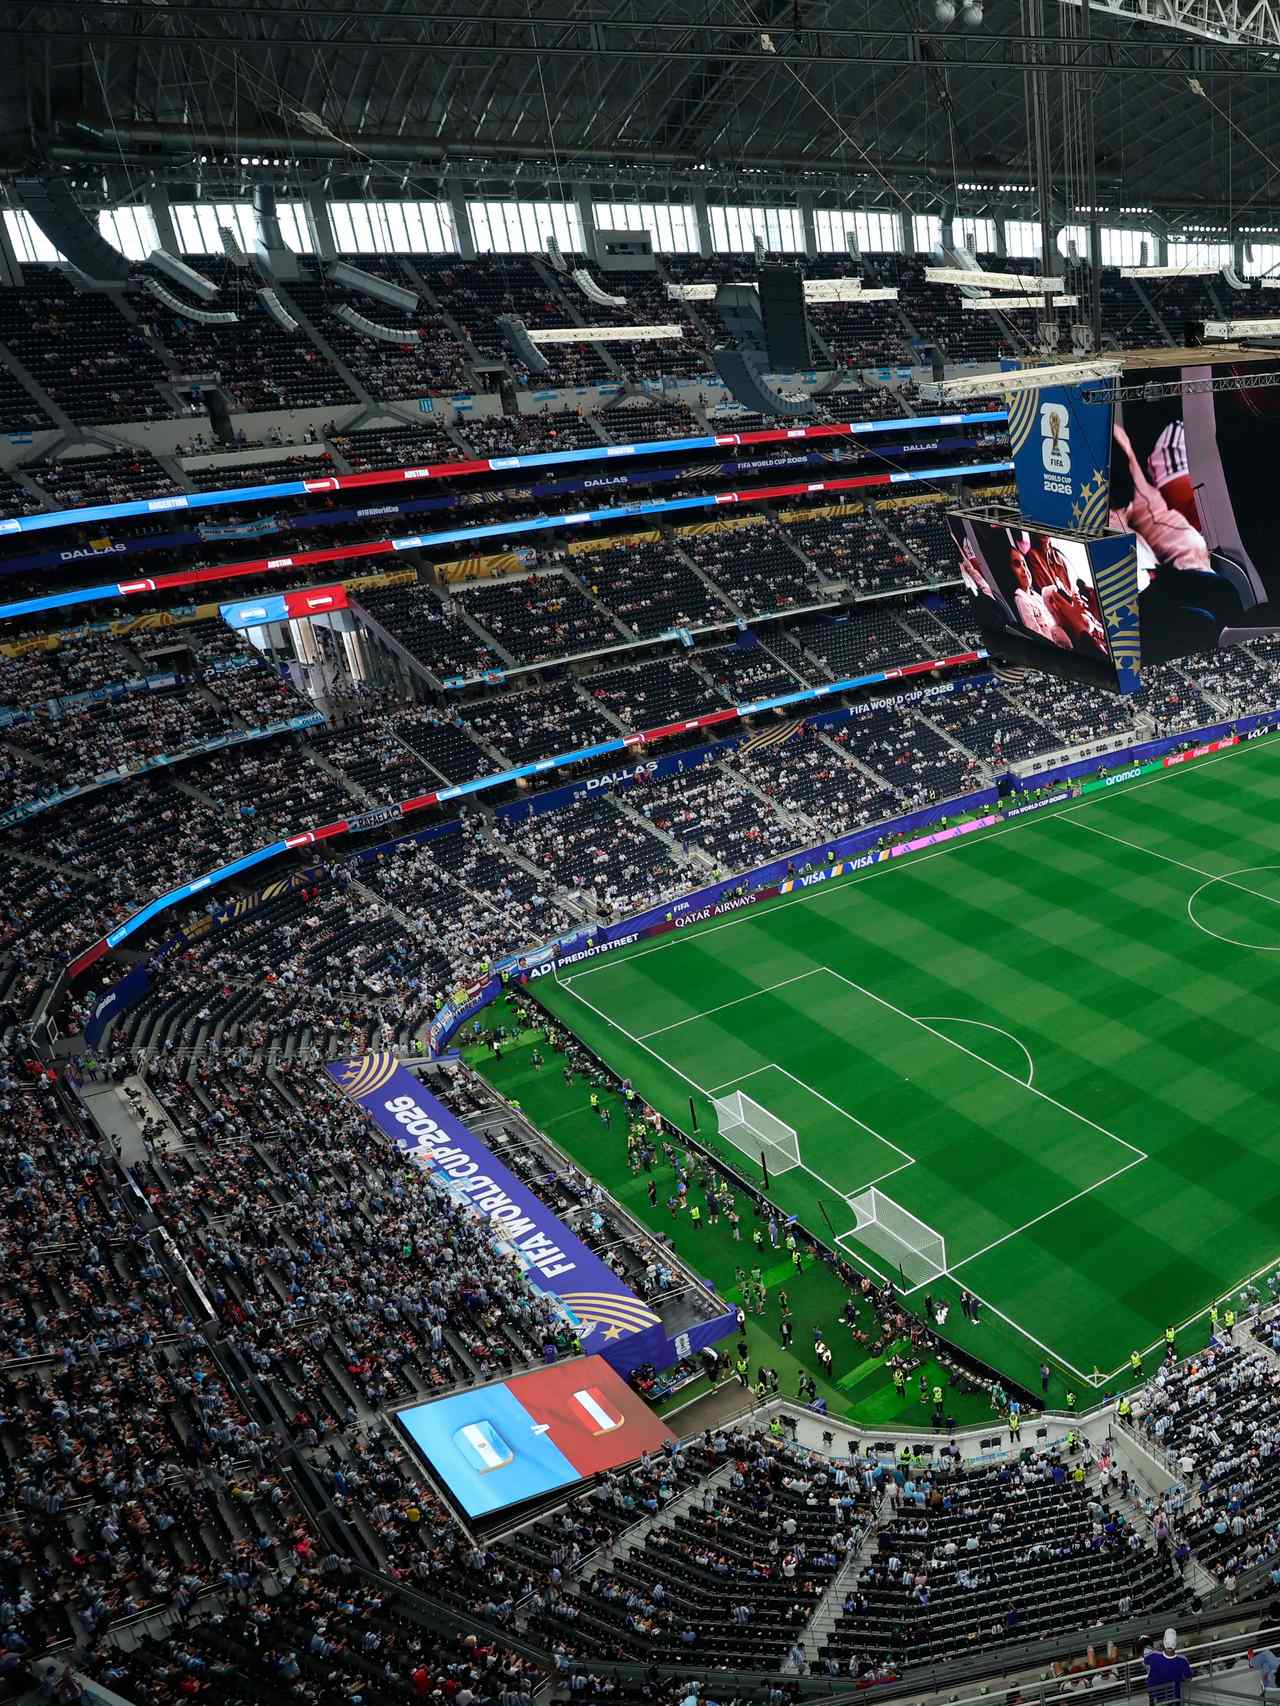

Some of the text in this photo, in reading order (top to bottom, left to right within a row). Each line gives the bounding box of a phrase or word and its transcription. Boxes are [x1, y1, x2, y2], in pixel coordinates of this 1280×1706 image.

[903, 442, 938, 452] DALLAS
[737, 455, 808, 470] FIFA WORLD CUP 2026
[1051, 459, 1064, 467] FIFA
[584, 476, 629, 488] DALLAS
[1043, 473, 1072, 484] WORLD CUP
[1044, 481, 1072, 495] 2026
[61, 543, 127, 561] DALLAS
[849, 683, 955, 716] FIFA WORLD CUP 2026
[586, 761, 660, 791] DALLAS
[1105, 768, 1141, 785] aramco
[850, 855, 875, 870] VISA
[800, 871, 827, 886] VISA
[673, 902, 690, 913] FIFA
[675, 894, 757, 928] QATAR AIRWAYS
[530, 932, 640, 979] ADI PREDICTSTREET
[384, 1096, 577, 1279] FIFA WORLD CUP 2026
